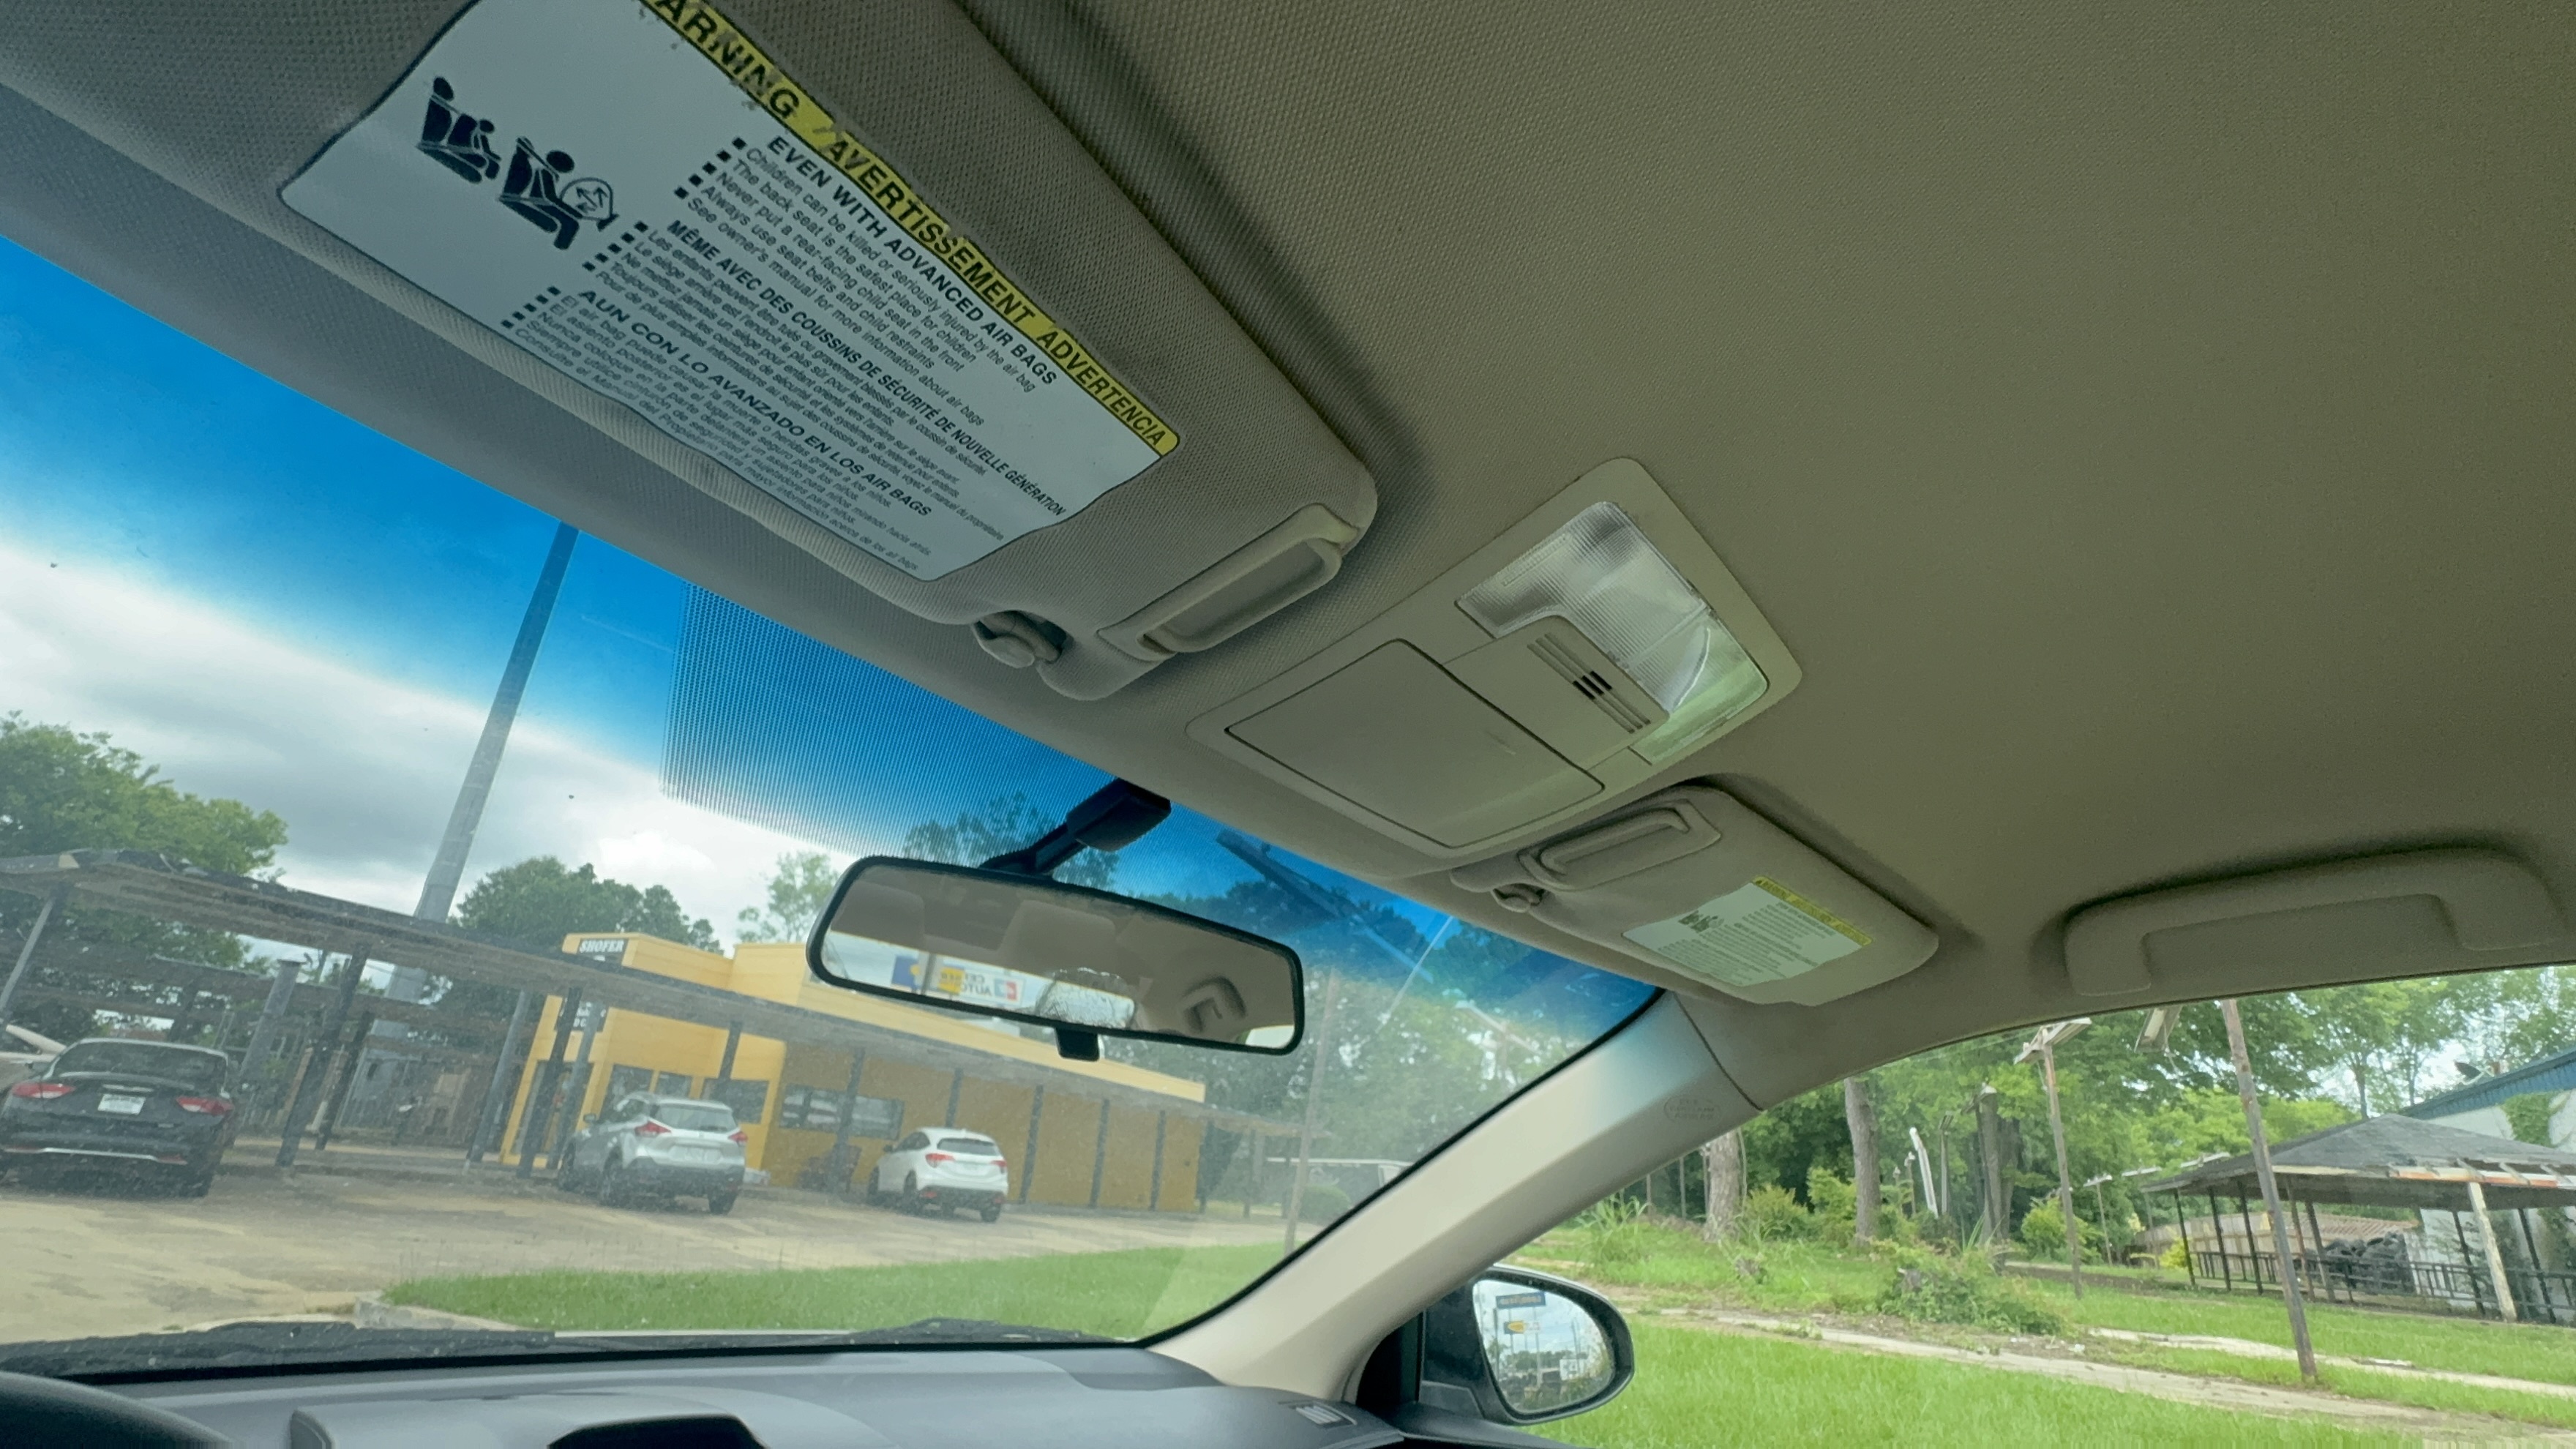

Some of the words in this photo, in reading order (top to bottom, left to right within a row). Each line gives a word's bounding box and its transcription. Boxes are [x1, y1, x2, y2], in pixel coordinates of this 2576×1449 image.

[687, 198, 717, 223] See
[717, 222, 769, 263] owner's
[768, 261, 817, 298] manual
[814, 294, 834, 311] for
[831, 309, 862, 334] more
[861, 332, 920, 376] information
[918, 375, 949, 398] about
[946, 396, 963, 408] air
[959, 405, 984, 426] bags
[700, 186, 751, 226] Always
[751, 224, 776, 247] use
[776, 244, 808, 270] seat
[805, 265, 836, 293] belts
[835, 291, 863, 312] and
[858, 310, 890, 333] child
[886, 331, 935, 369] restraints
[716, 171, 759, 206] Never
[755, 206, 784, 228] put
[780, 225, 793, 236] a
[793, 234, 858, 290] rear-facing
[857, 287, 888, 310] child
[884, 308, 912, 330] seat
[908, 326, 922, 340] in
[920, 336, 940, 353] the
[938, 349, 965, 372] front
[733, 158, 760, 185] The
[759, 181, 793, 213] back
[793, 210, 824, 237] seat
[821, 232, 836, 247] is
[835, 245, 856, 265] the
[855, 263, 894, 293] safest
[888, 291, 921, 318] place
[920, 315, 938, 331] for
[936, 330, 976, 363] children
[746, 148, 803, 196] Children
[802, 194, 828, 217] can
[827, 213, 846, 233] be
[845, 231, 882, 261] killed
[877, 259, 894, 272] or
[891, 269, 941, 312] seriously
[939, 309, 978, 342] injured
[973, 337, 989, 353] by
[986, 348, 1005, 365] the
[1002, 364, 1019, 376] air
[1016, 373, 1036, 393] bag
[767, 136, 832, 188] EVEN
[833, 186, 888, 239] WITH
[884, 239, 984, 321] ADVANCED
[980, 322, 1014, 347] AIR
[1011, 344, 1057, 384] BAGS
[828, 139, 1035, 322] AVERTISSEMENT
[578, 291, 630, 323] AUN
[631, 323, 679, 355] CON
[678, 353, 709, 374] LO
[708, 375, 805, 436] AVANZADO
[804, 435, 831, 454] EN
[829, 452, 864, 474] LOS
[861, 473, 891, 491] AIR
[889, 488, 932, 516] BAGS
[667, 220, 720, 261] MÊME
[716, 258, 762, 291] AVEC
[759, 287, 794, 314] DES
[791, 312, 862, 364] COUSSINS
[858, 360, 883, 378] DE
[877, 375, 941, 420] SÉCURITÉ
[934, 416, 956, 433] DE
[951, 429, 1009, 473] NOUVELLE
[1005, 470, 1066, 516] GÉNÉRATION
[1036, 332, 1165, 445] ADVERTENCIA
